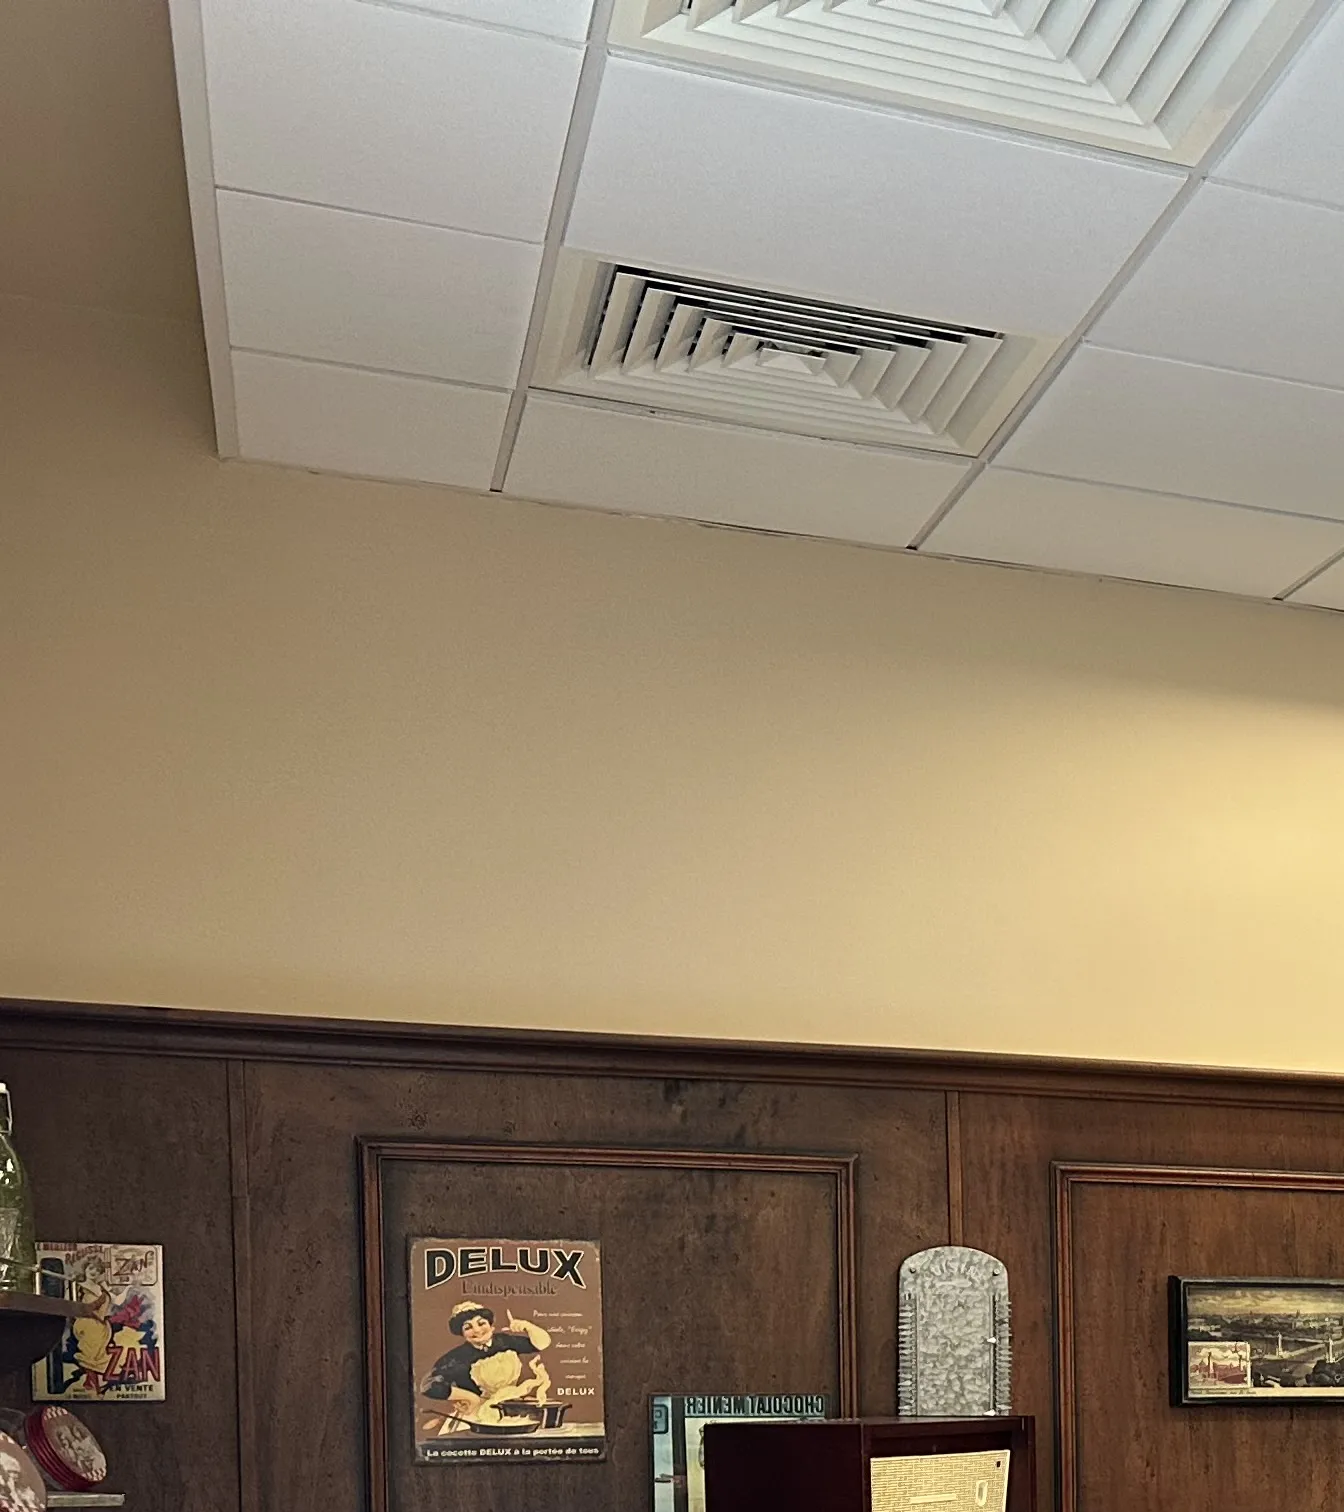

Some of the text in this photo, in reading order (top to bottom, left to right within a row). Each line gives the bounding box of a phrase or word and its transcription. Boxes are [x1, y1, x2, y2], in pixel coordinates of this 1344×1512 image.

[425, 1246, 587, 1290] DELUX
[103, 1345, 161, 1383] ZAN
[125, 1384, 154, 1392] VENTE
[557, 1387, 595, 1396] DELUX
[479, 1448, 512, 1456] DELUX
